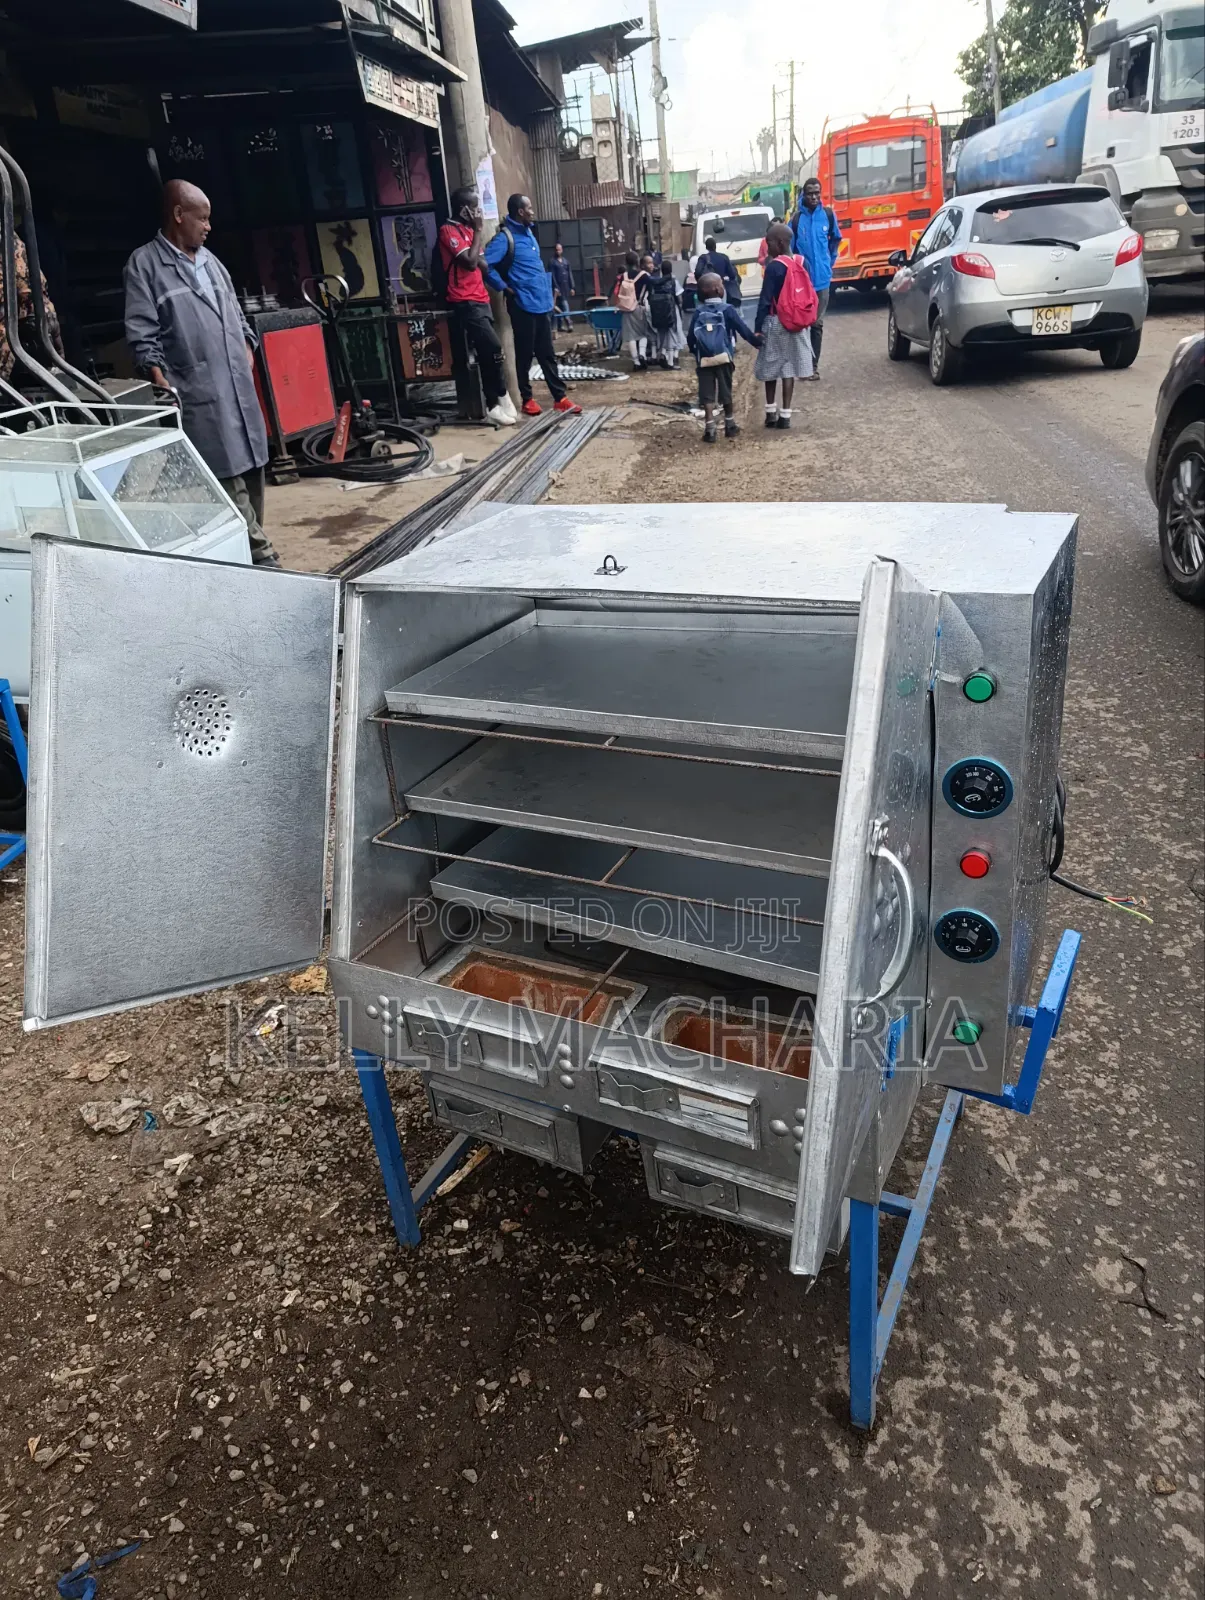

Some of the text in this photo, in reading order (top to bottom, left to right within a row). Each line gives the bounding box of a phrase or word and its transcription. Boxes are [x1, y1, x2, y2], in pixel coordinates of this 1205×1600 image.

[1181, 114, 1196, 126] 33
[1172, 127, 1201, 139] 1203
[1035, 306, 1060, 321] KCW
[1035, 319, 1069, 334] 966S
